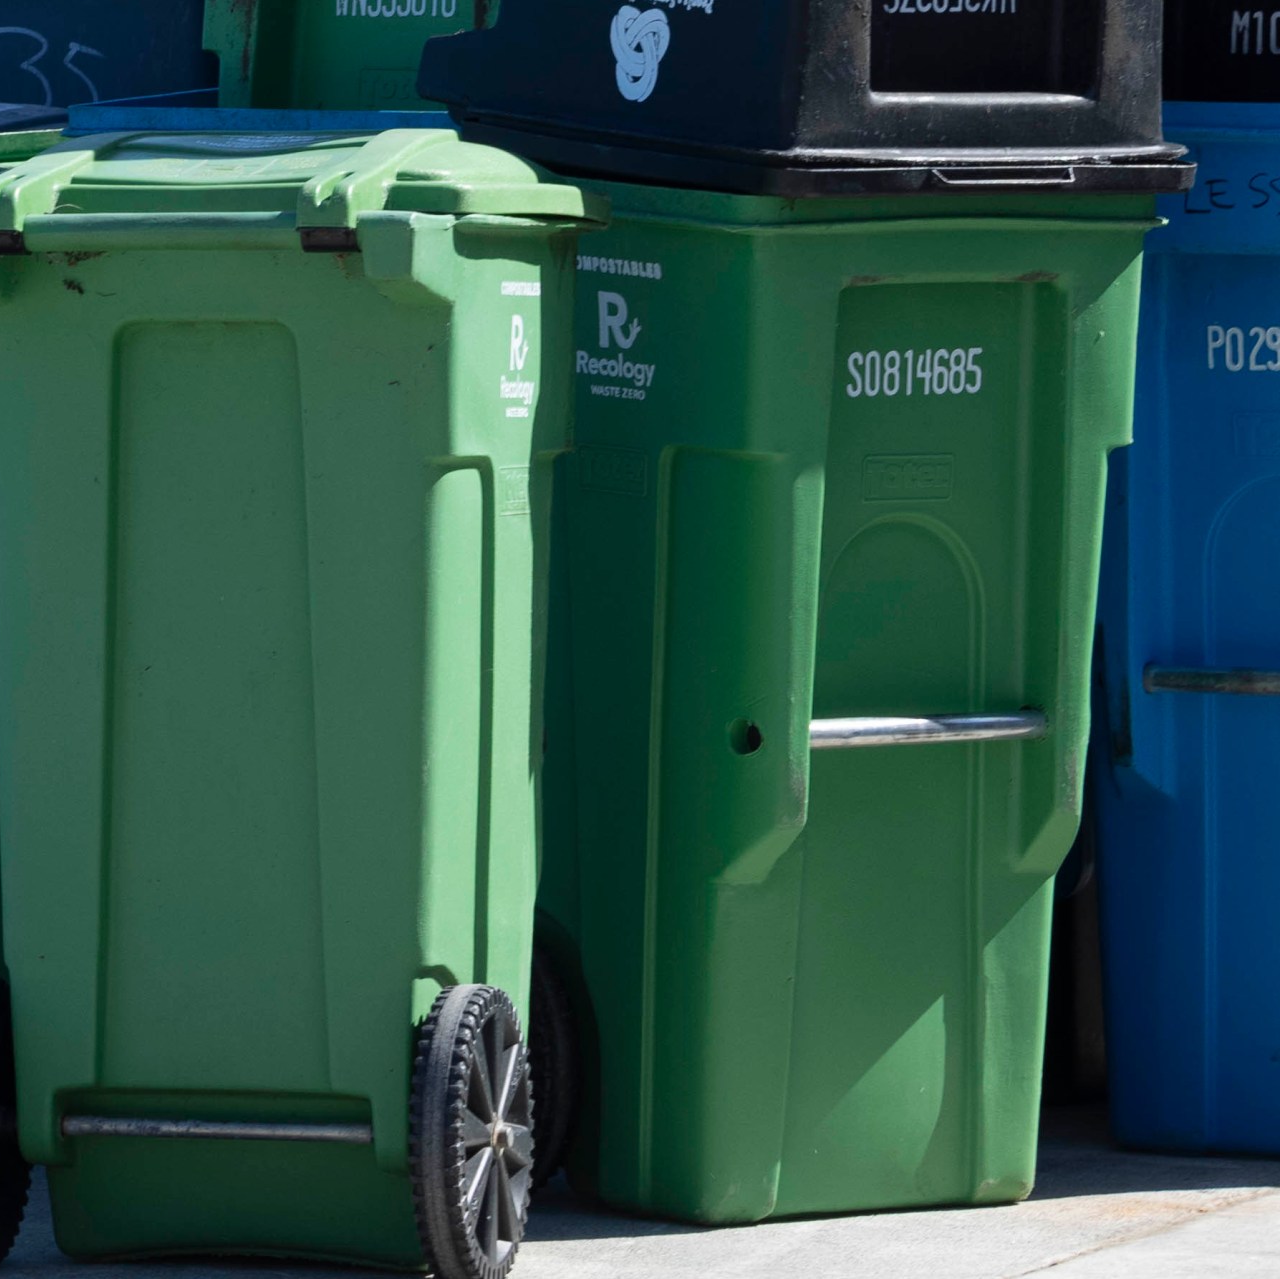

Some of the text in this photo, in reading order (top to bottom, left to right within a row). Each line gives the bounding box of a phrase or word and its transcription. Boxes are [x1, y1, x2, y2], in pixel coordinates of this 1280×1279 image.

[576, 350, 656, 388] Recology
[846, 347, 983, 399] S0814685
[590, 384, 646, 400] WASTE ZERO
